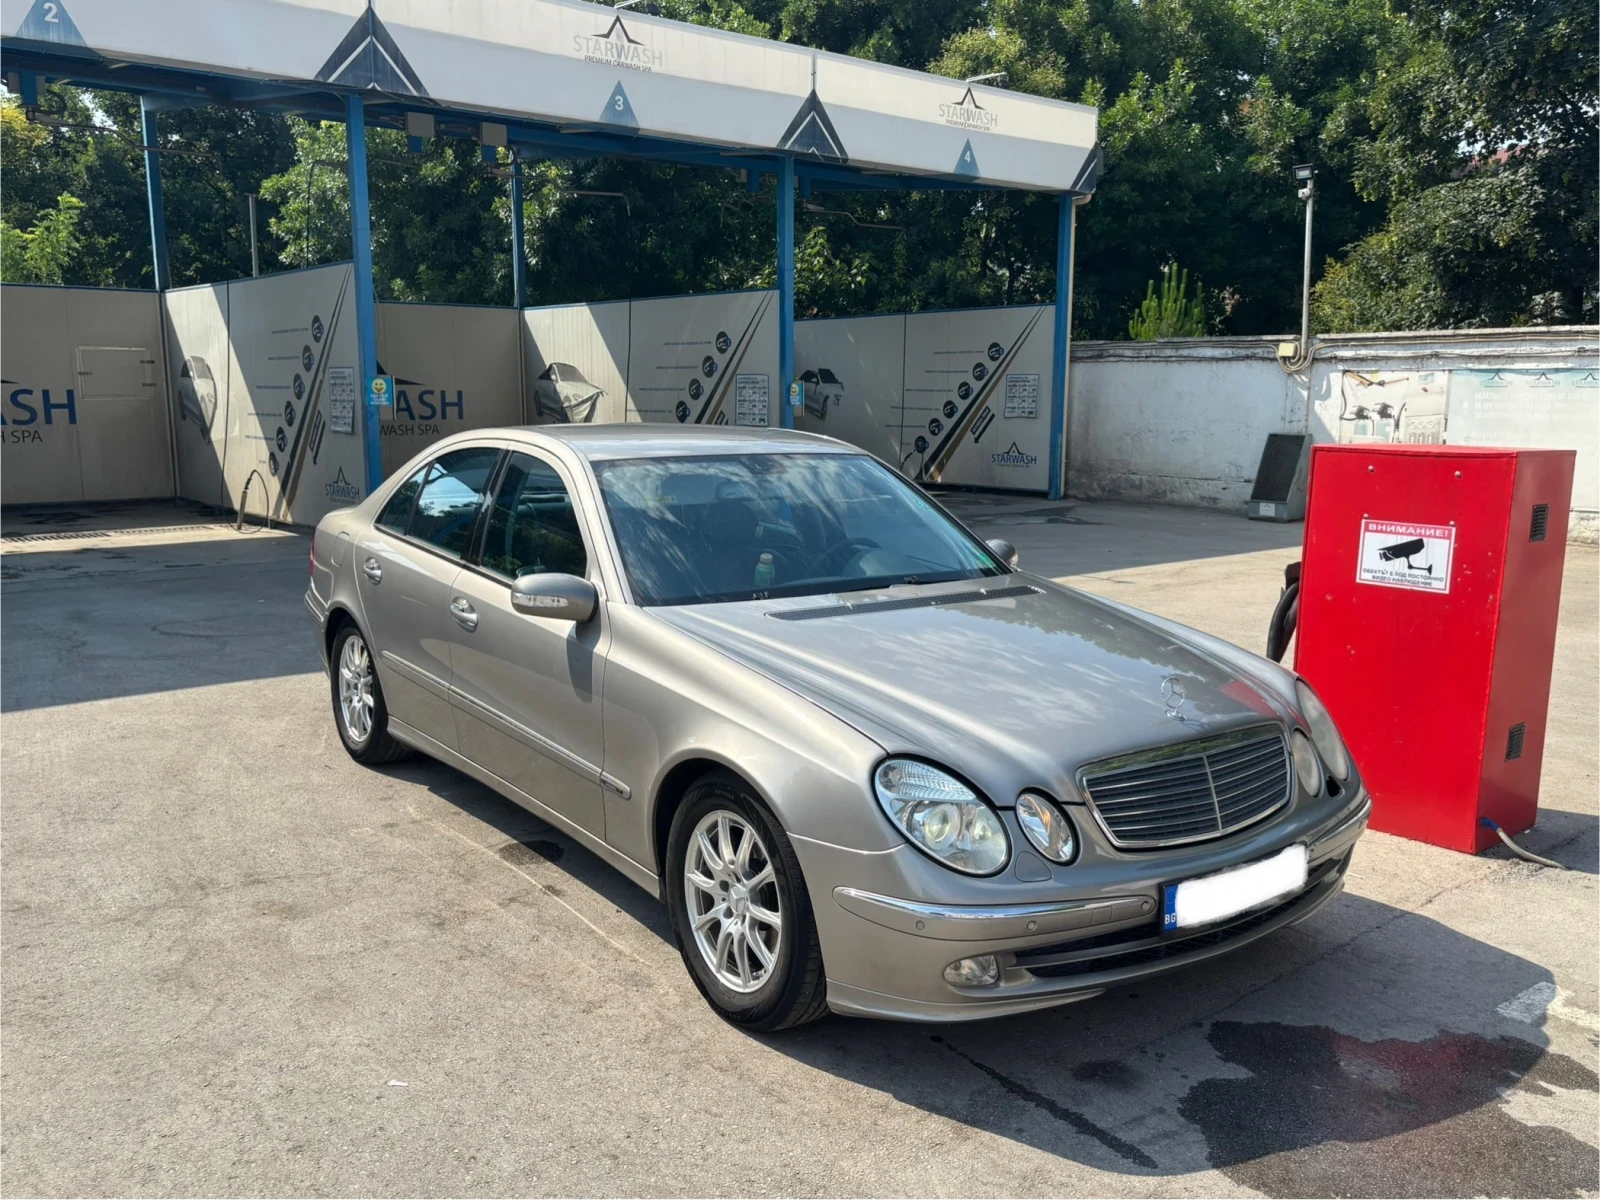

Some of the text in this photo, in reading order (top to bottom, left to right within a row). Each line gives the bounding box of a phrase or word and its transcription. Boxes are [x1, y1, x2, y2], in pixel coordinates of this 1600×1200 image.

[43, 2, 59, 23] 2
[573, 35, 663, 67] STARWASH
[584, 54, 652, 73] PREMIUM CARWASH SPA
[615, 95, 624, 111] 3
[938, 104, 998, 127] STARWASH
[964, 150, 971, 163] 4
[11, 429, 43, 444] SPA
[417, 424, 440, 436] SPA
[991, 453, 1037, 465] STARWASH
[324, 483, 361, 500] STARWASH
[1368, 523, 1448, 537] ВНИМАНИЕ!
[1371, 574, 1432, 586] ВИДЕО НАБЛЮДЕНИЕ
[1408, 573, 1444, 582] ПОСТОЯННО
[1164, 912, 1177, 925] BG
